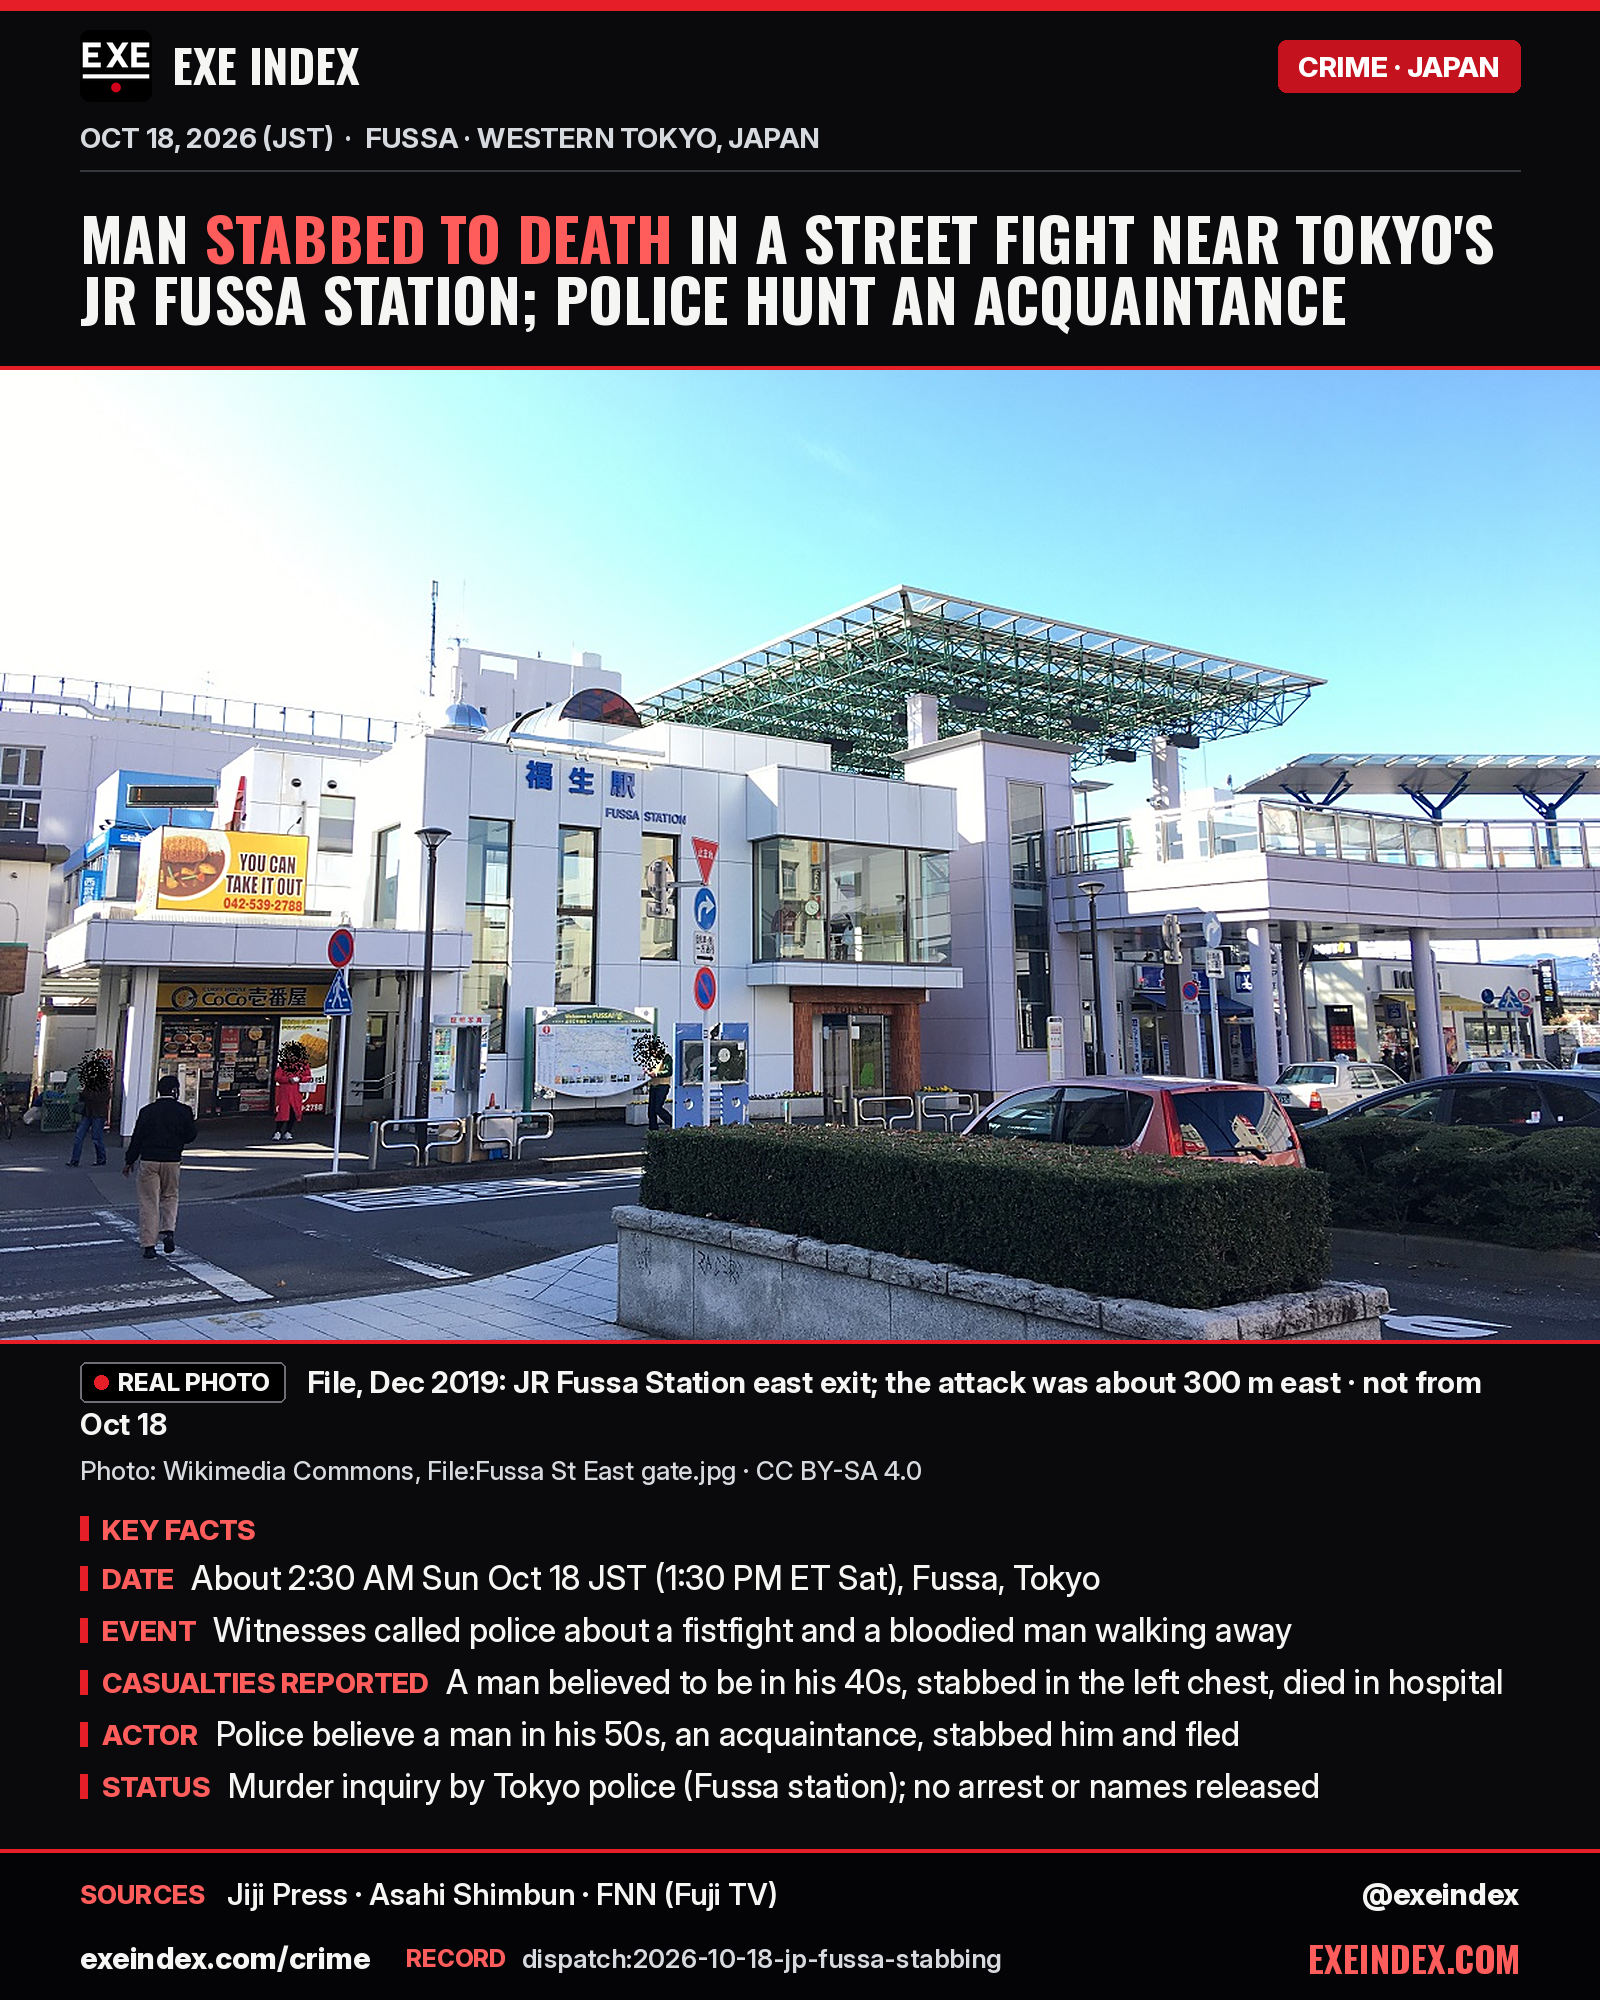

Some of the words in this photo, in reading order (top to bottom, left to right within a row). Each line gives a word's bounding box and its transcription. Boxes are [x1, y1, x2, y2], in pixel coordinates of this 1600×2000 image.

[525, 760, 636, 799] 福生駅
[605, 807, 640, 821] FUSSA
[643, 811, 687, 825] STATION
[240, 853, 267, 872] YOU
[269, 854, 296, 874] CAN
[226, 875, 258, 894] TAKE
[260, 877, 274, 895] IT
[277, 877, 303, 896] OUT
[223, 897, 303, 912] 042-539-2788
